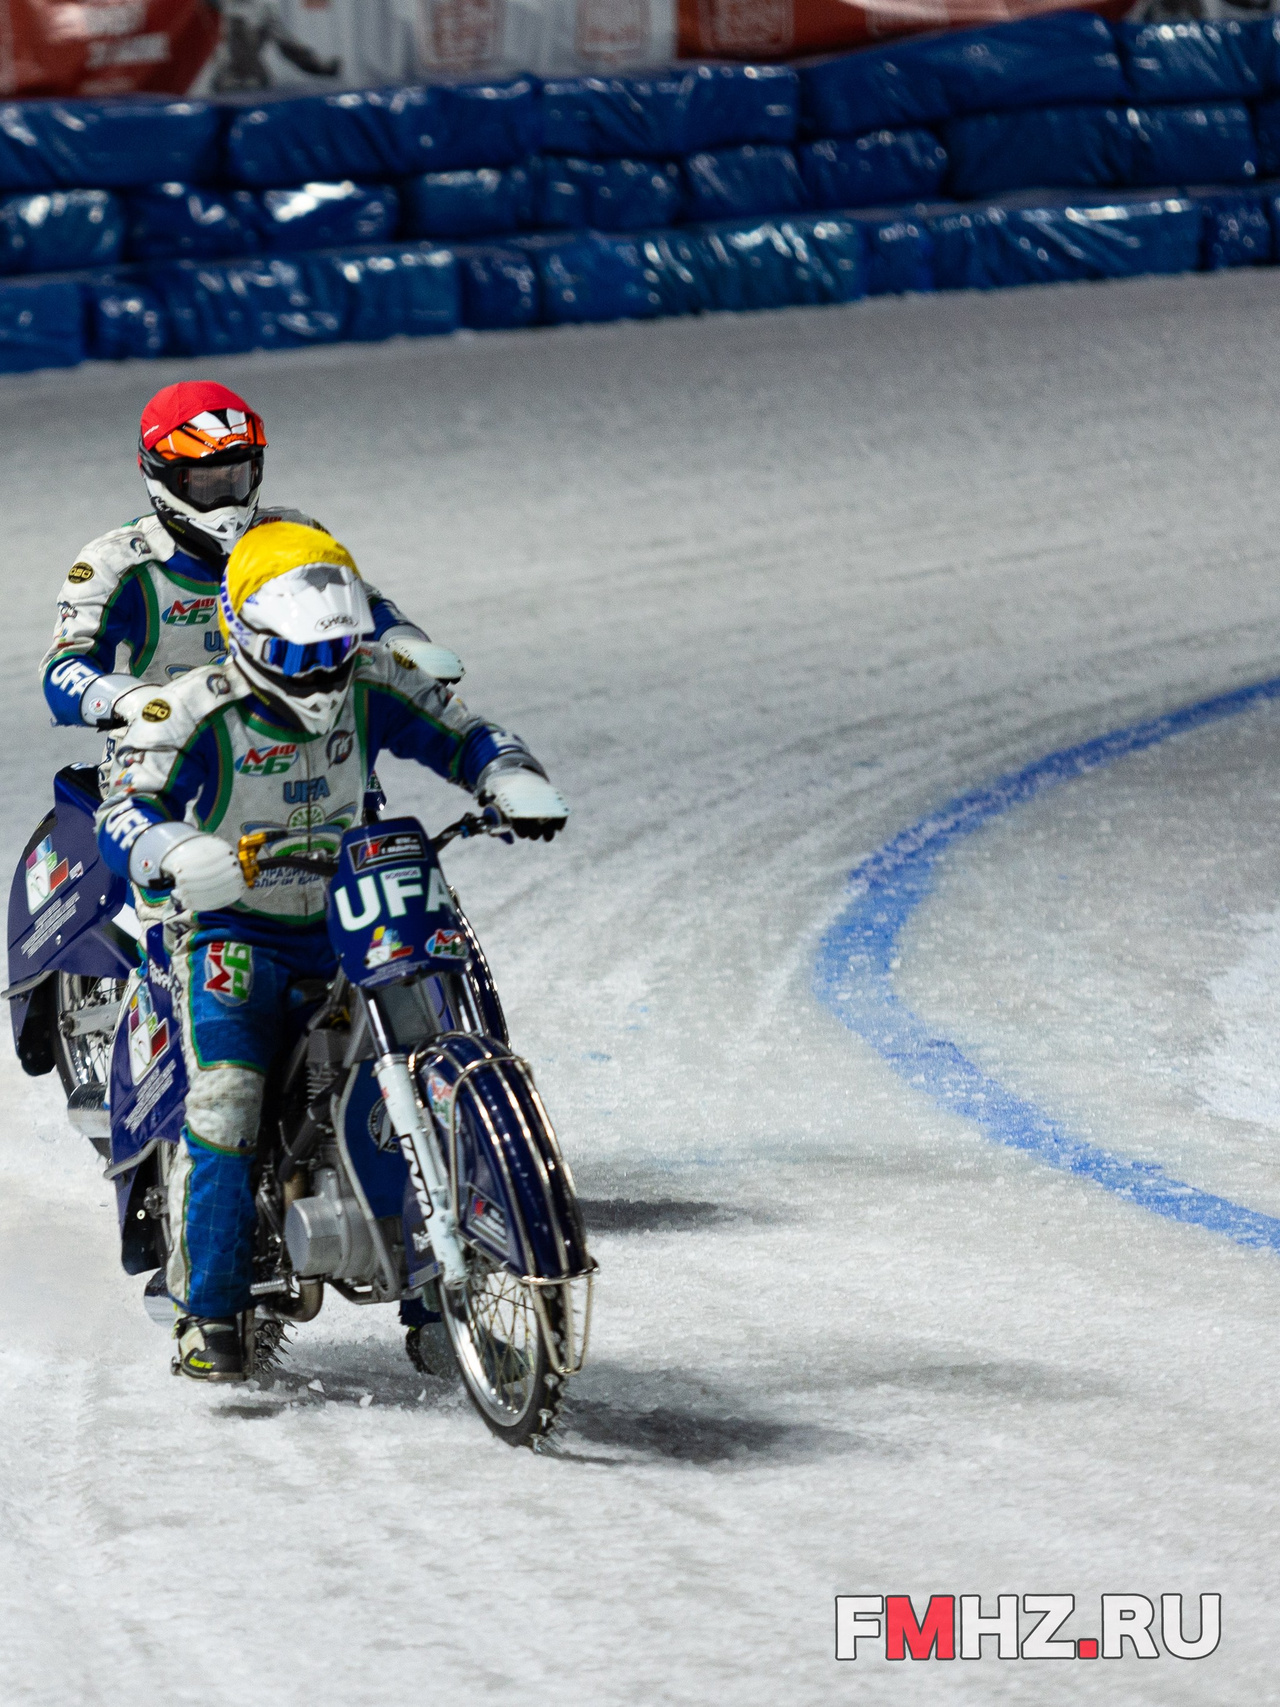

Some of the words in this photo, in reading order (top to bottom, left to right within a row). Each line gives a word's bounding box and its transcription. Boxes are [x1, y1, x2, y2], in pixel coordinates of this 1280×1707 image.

[50, 658, 101, 698] UFA
[282, 775, 331, 804] UFA
[105, 798, 153, 851] UFA
[334, 866, 458, 932] UFA
